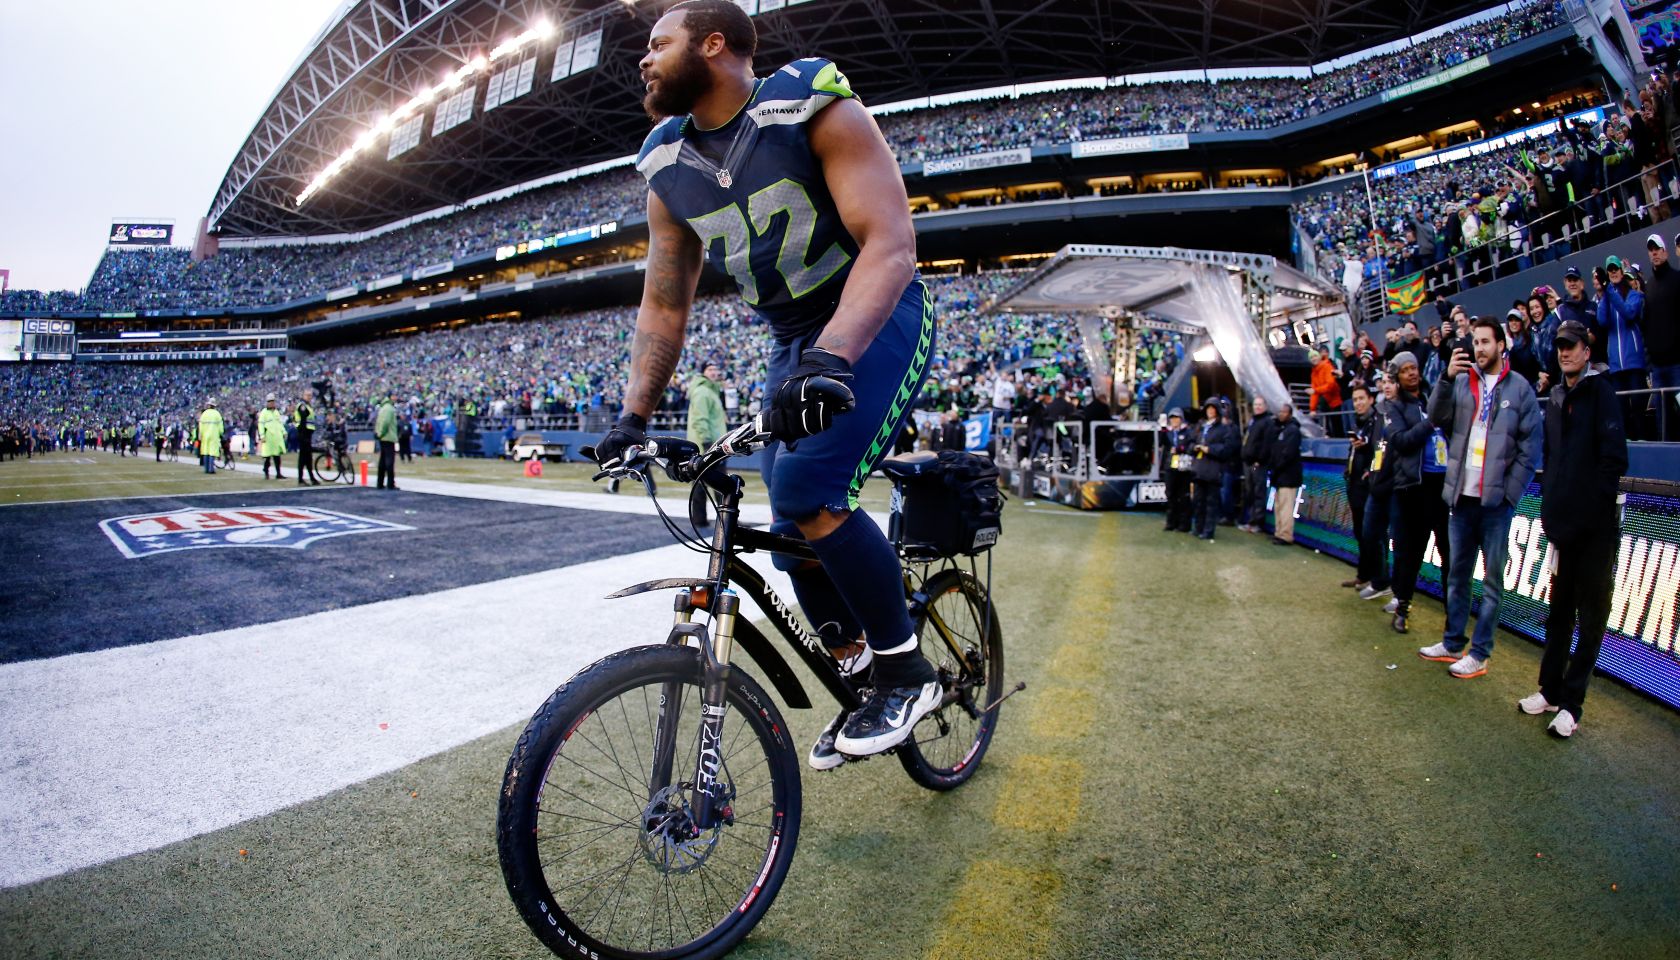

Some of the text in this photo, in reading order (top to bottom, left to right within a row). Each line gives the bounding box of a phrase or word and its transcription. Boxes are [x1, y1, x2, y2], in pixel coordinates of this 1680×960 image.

[687, 178, 851, 305] 72
[120, 353, 145, 361] HOME
[217, 351, 238, 359] MAN
[529, 462, 541, 477] G
[1143, 484, 1167, 500] FOX
[129, 508, 317, 532] NFL
[976, 530, 996, 542] POLICE
[697, 723, 722, 797] FOX
[539, 901, 599, 960] SERFAS
